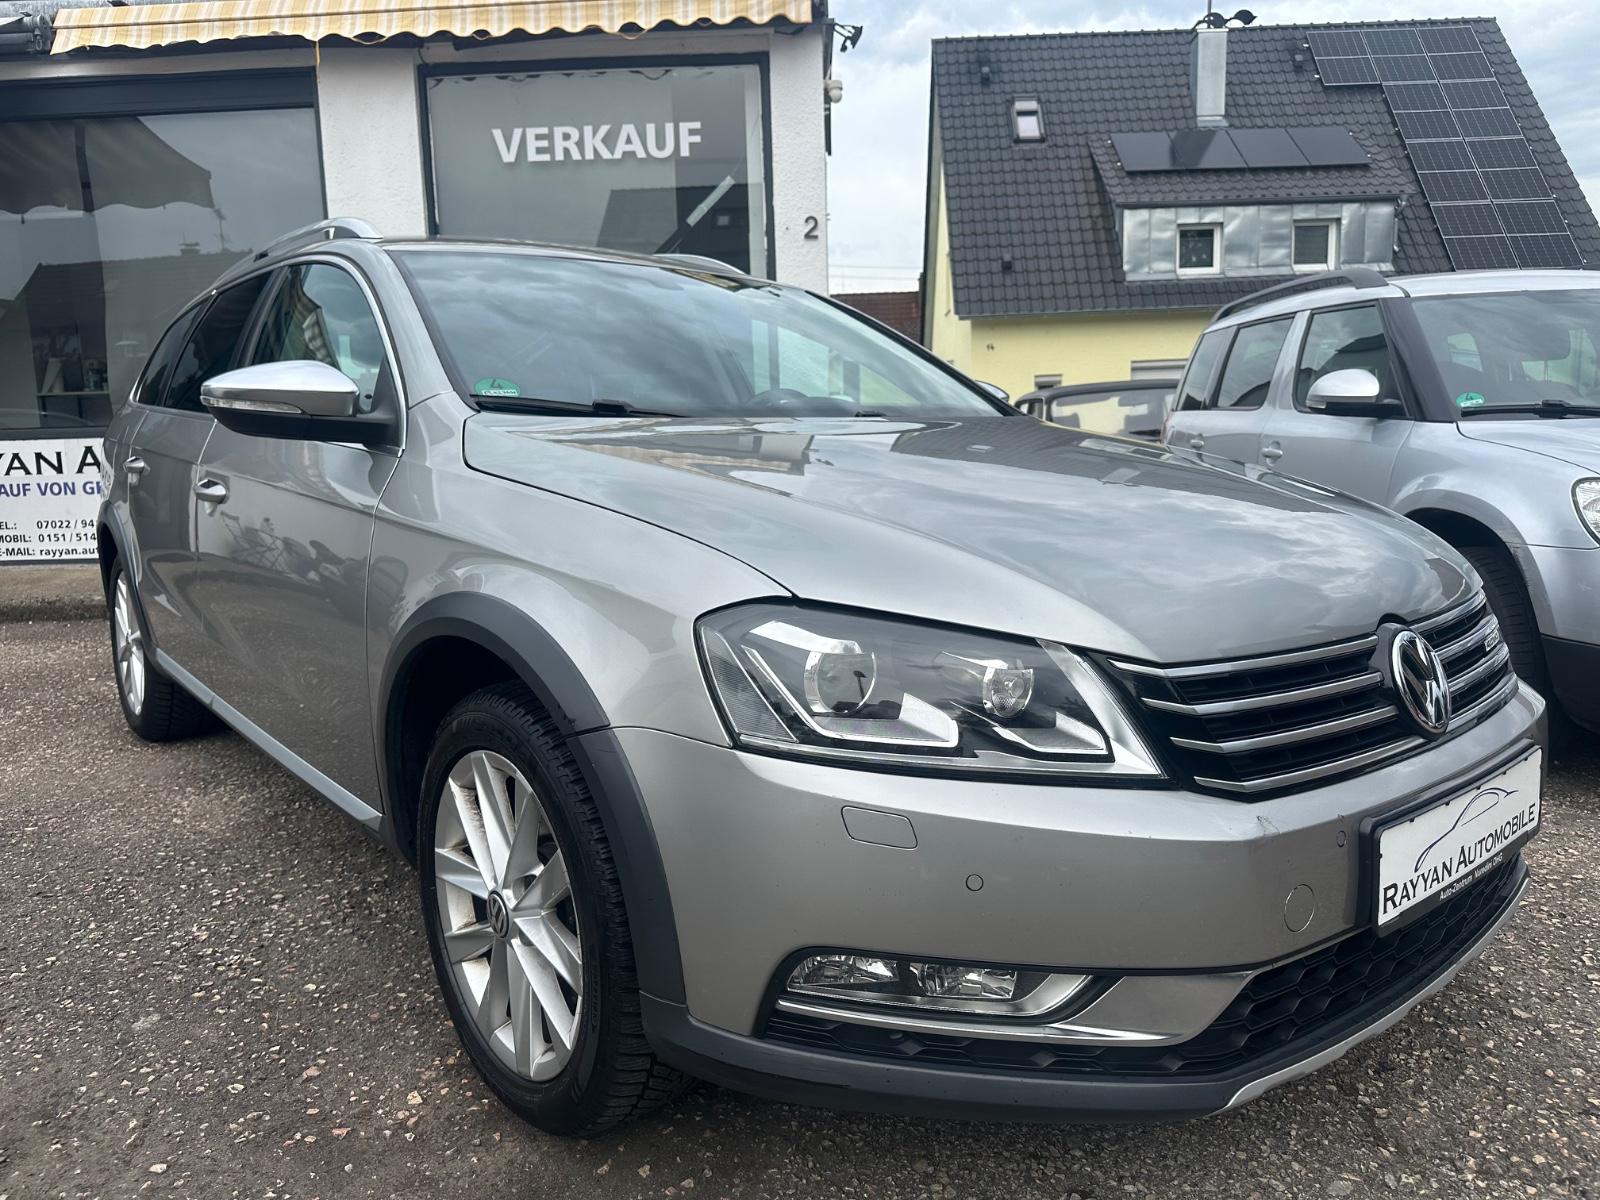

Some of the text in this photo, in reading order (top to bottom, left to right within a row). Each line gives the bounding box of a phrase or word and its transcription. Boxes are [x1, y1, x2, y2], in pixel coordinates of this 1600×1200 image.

[491, 121, 702, 163] VERKAUF
[804, 215, 818, 240] 2
[0, 452, 64, 476] AN
[36, 481, 76, 497] VON
[36, 520, 71, 529] 07022
[80, 519, 95, 529] 94
[38, 533, 66, 543] 0151
[75, 532, 97, 542] 514
[1382, 802, 1536, 915] RAYYAN AUTOMOBILE
